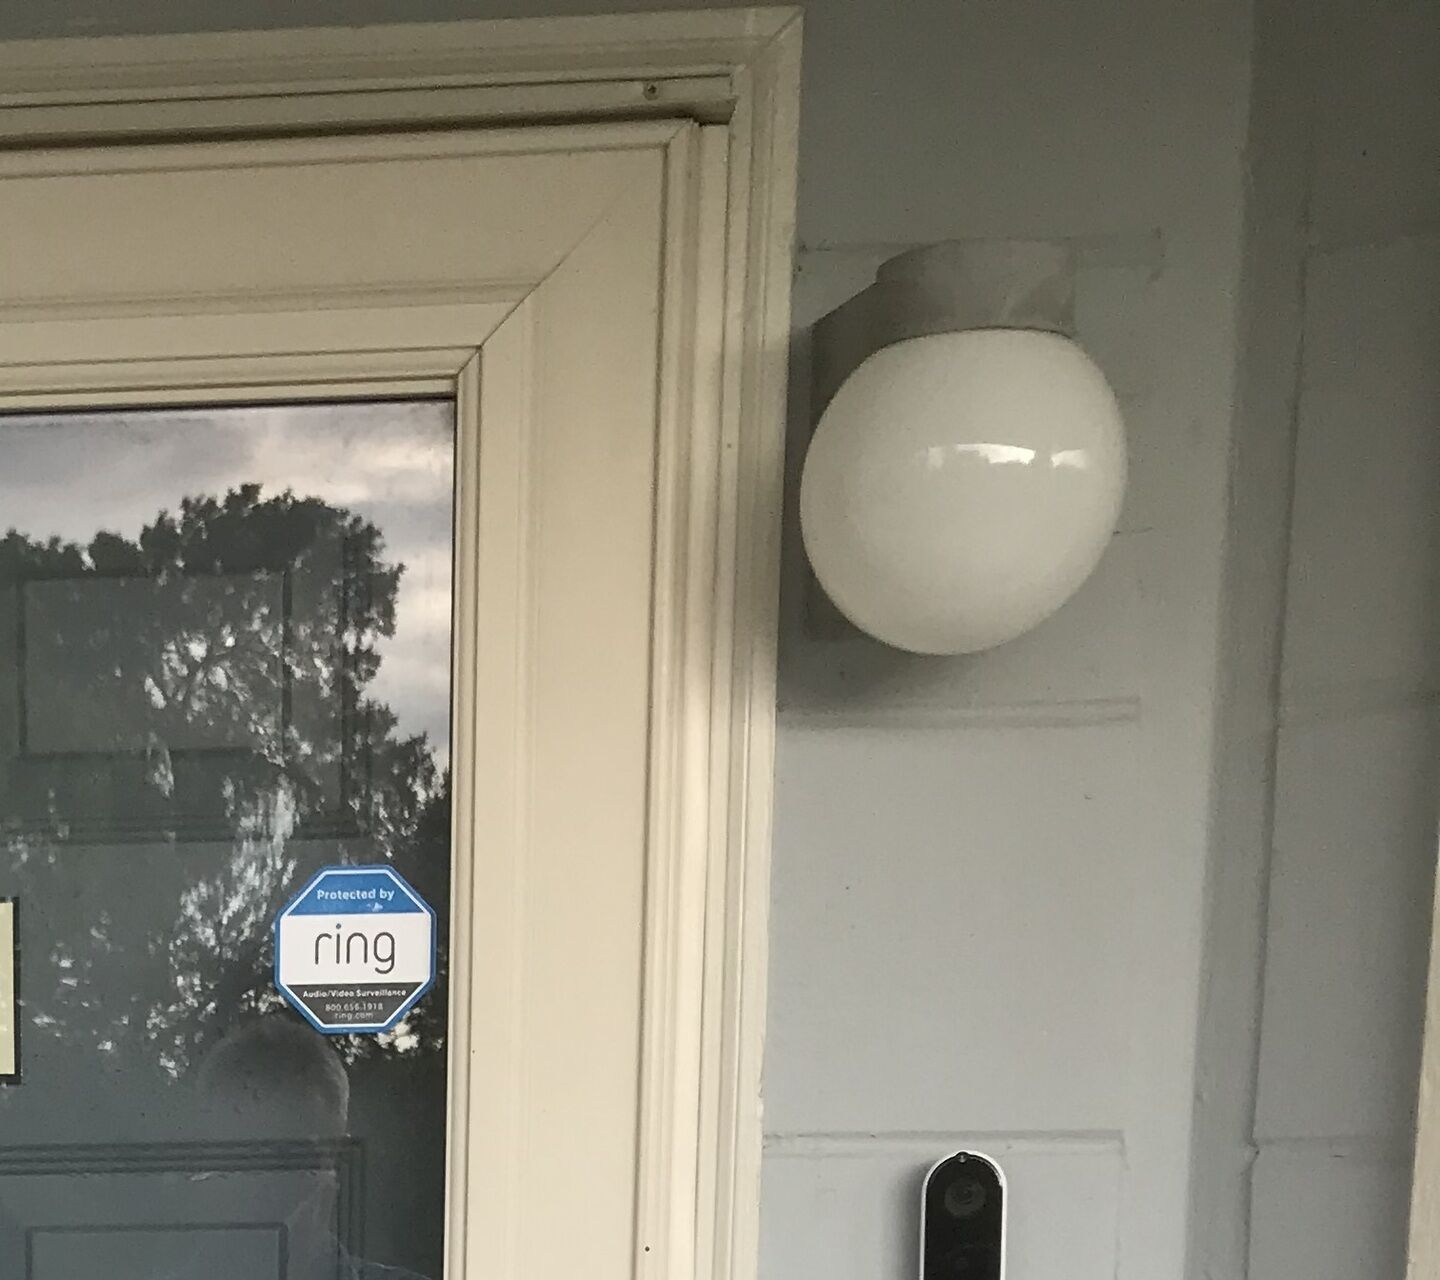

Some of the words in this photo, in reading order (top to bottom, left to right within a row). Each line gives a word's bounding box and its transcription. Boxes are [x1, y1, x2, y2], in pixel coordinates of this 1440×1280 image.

[317, 889, 376, 900] Protected
[379, 889, 394, 901] by
[315, 923, 396, 974] ring
[303, 990, 354, 998] Audio/Video
[356, 989, 406, 997] Surveillance
